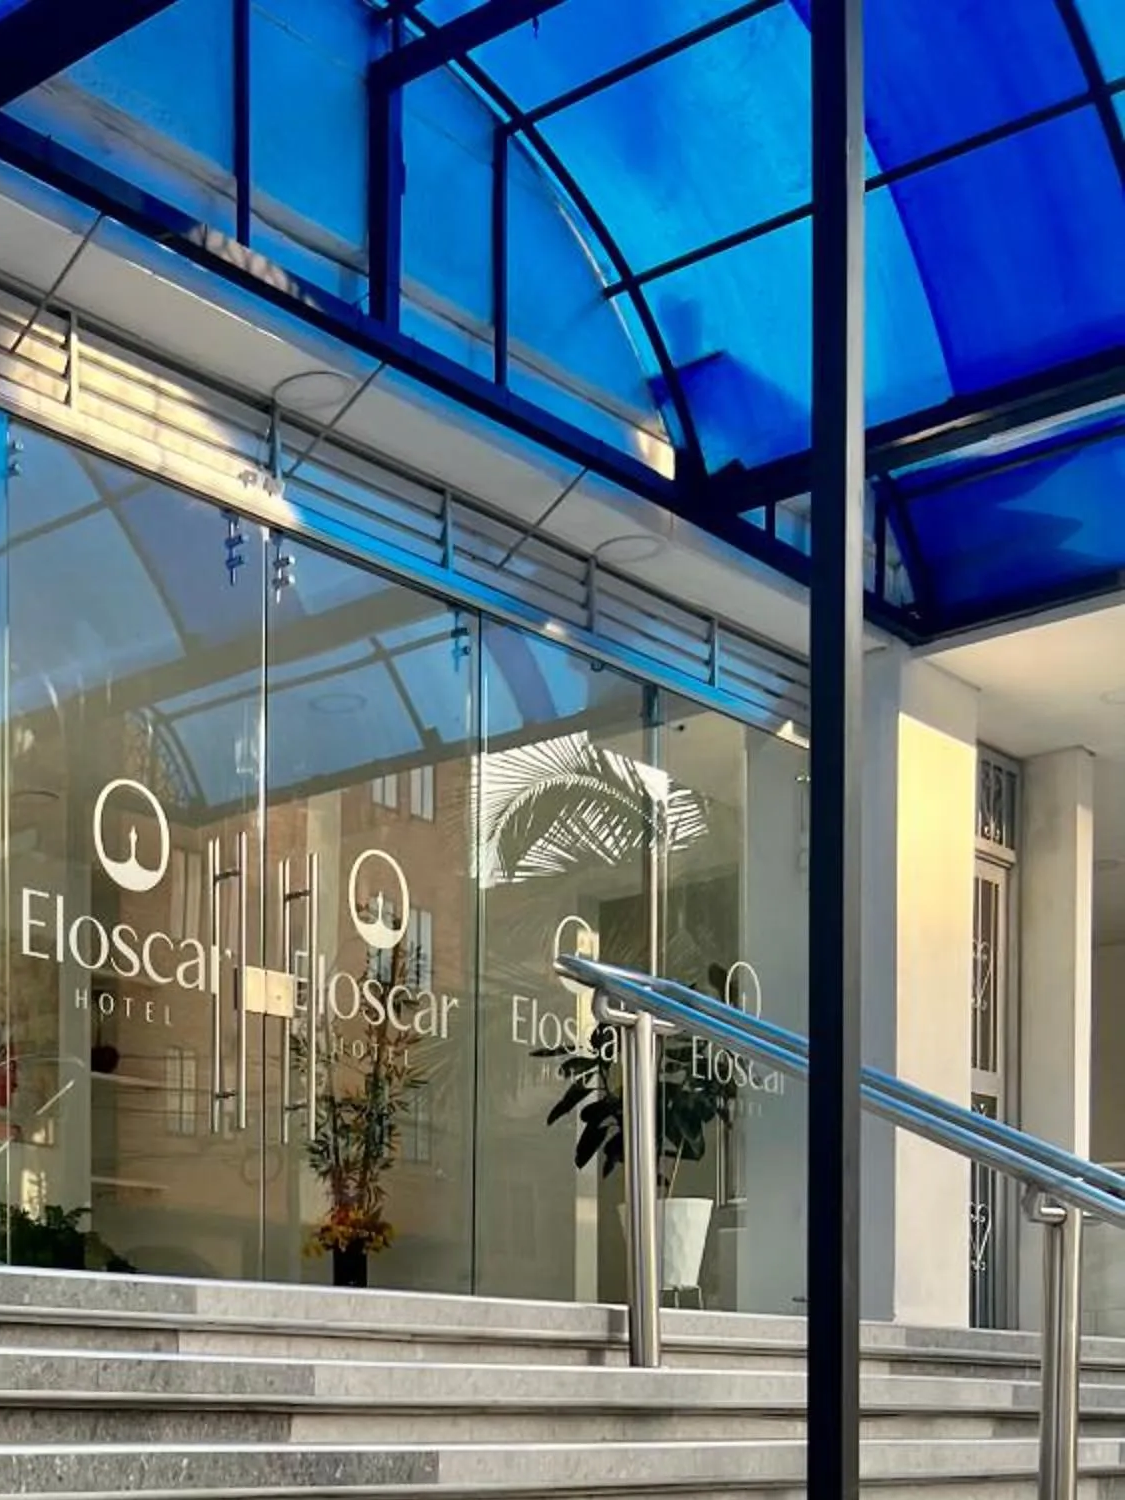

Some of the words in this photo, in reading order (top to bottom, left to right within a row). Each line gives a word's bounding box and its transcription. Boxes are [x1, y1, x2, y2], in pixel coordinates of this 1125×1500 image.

[21, 887, 233, 994] Eloscar
[75, 988, 173, 1026] HOTEL
[294, 950, 460, 1040] Eloscar
